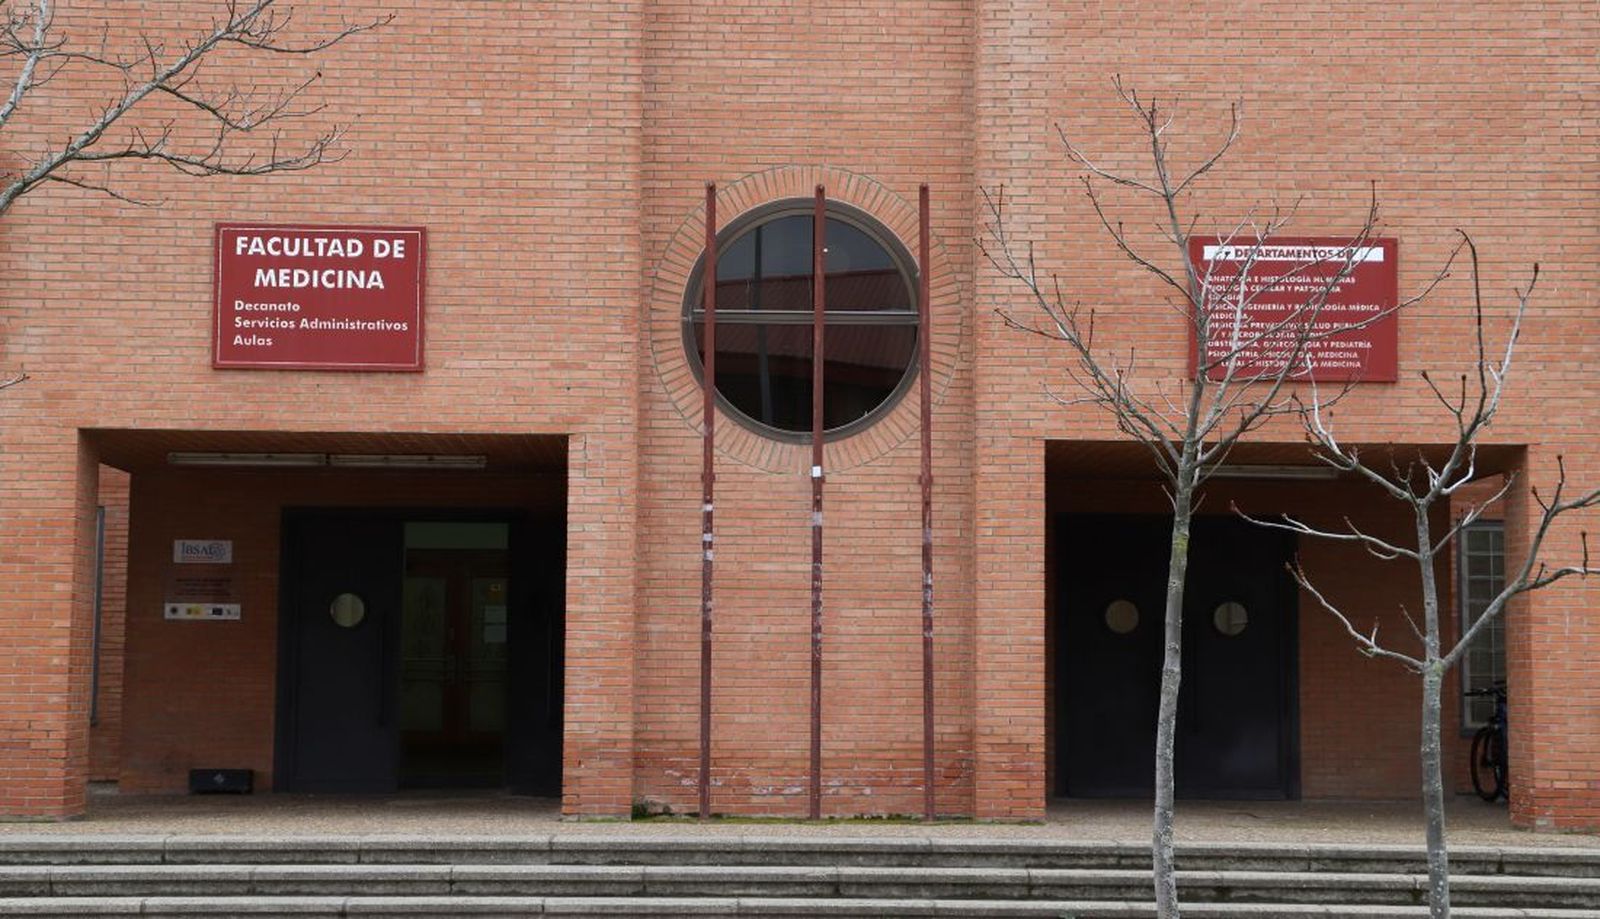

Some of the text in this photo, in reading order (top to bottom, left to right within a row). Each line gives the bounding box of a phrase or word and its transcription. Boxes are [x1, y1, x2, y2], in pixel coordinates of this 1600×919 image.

[235, 236, 406, 259] FACULTAD DE
[254, 268, 385, 290] MEDICINA
[234, 300, 301, 312] Decanato
[1287, 303, 1292, 311] Y
[234, 316, 409, 331] Servicios Administrativos
[233, 335, 273, 346] Aulas
